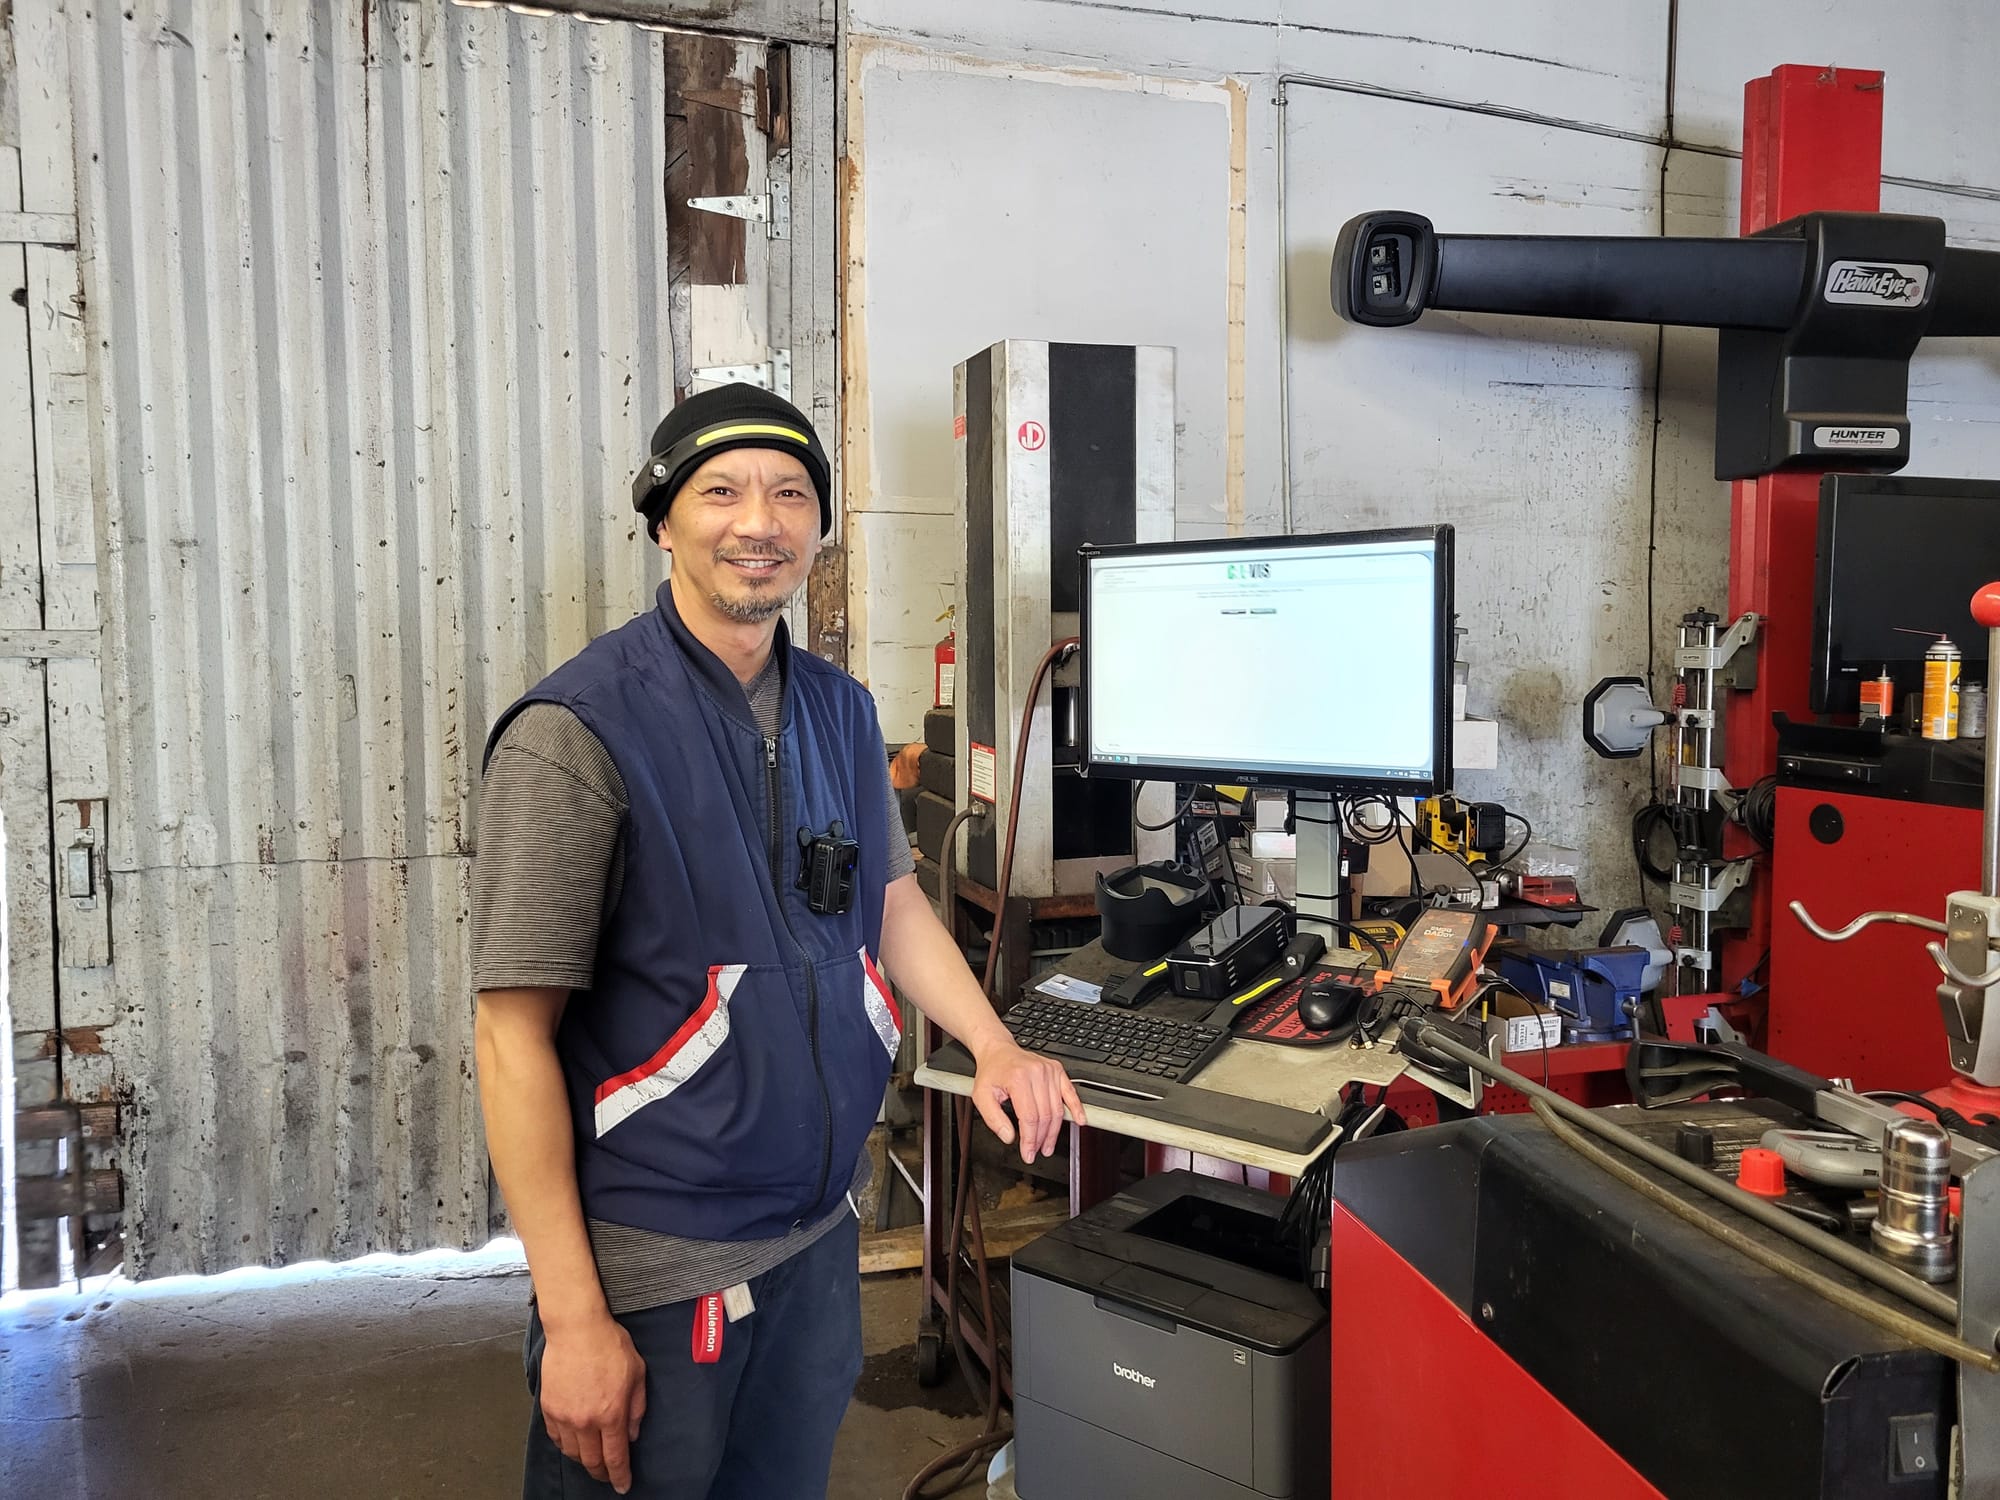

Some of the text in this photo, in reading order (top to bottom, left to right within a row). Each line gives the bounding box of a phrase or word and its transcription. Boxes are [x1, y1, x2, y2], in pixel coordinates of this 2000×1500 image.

[1831, 269, 1906, 298] HawkEye
[1830, 430, 1886, 439] HUNTER
[1235, 775, 1259, 783] ASUS
[706, 1296, 718, 1352] lululemon
[1112, 1361, 1156, 1388] brother
